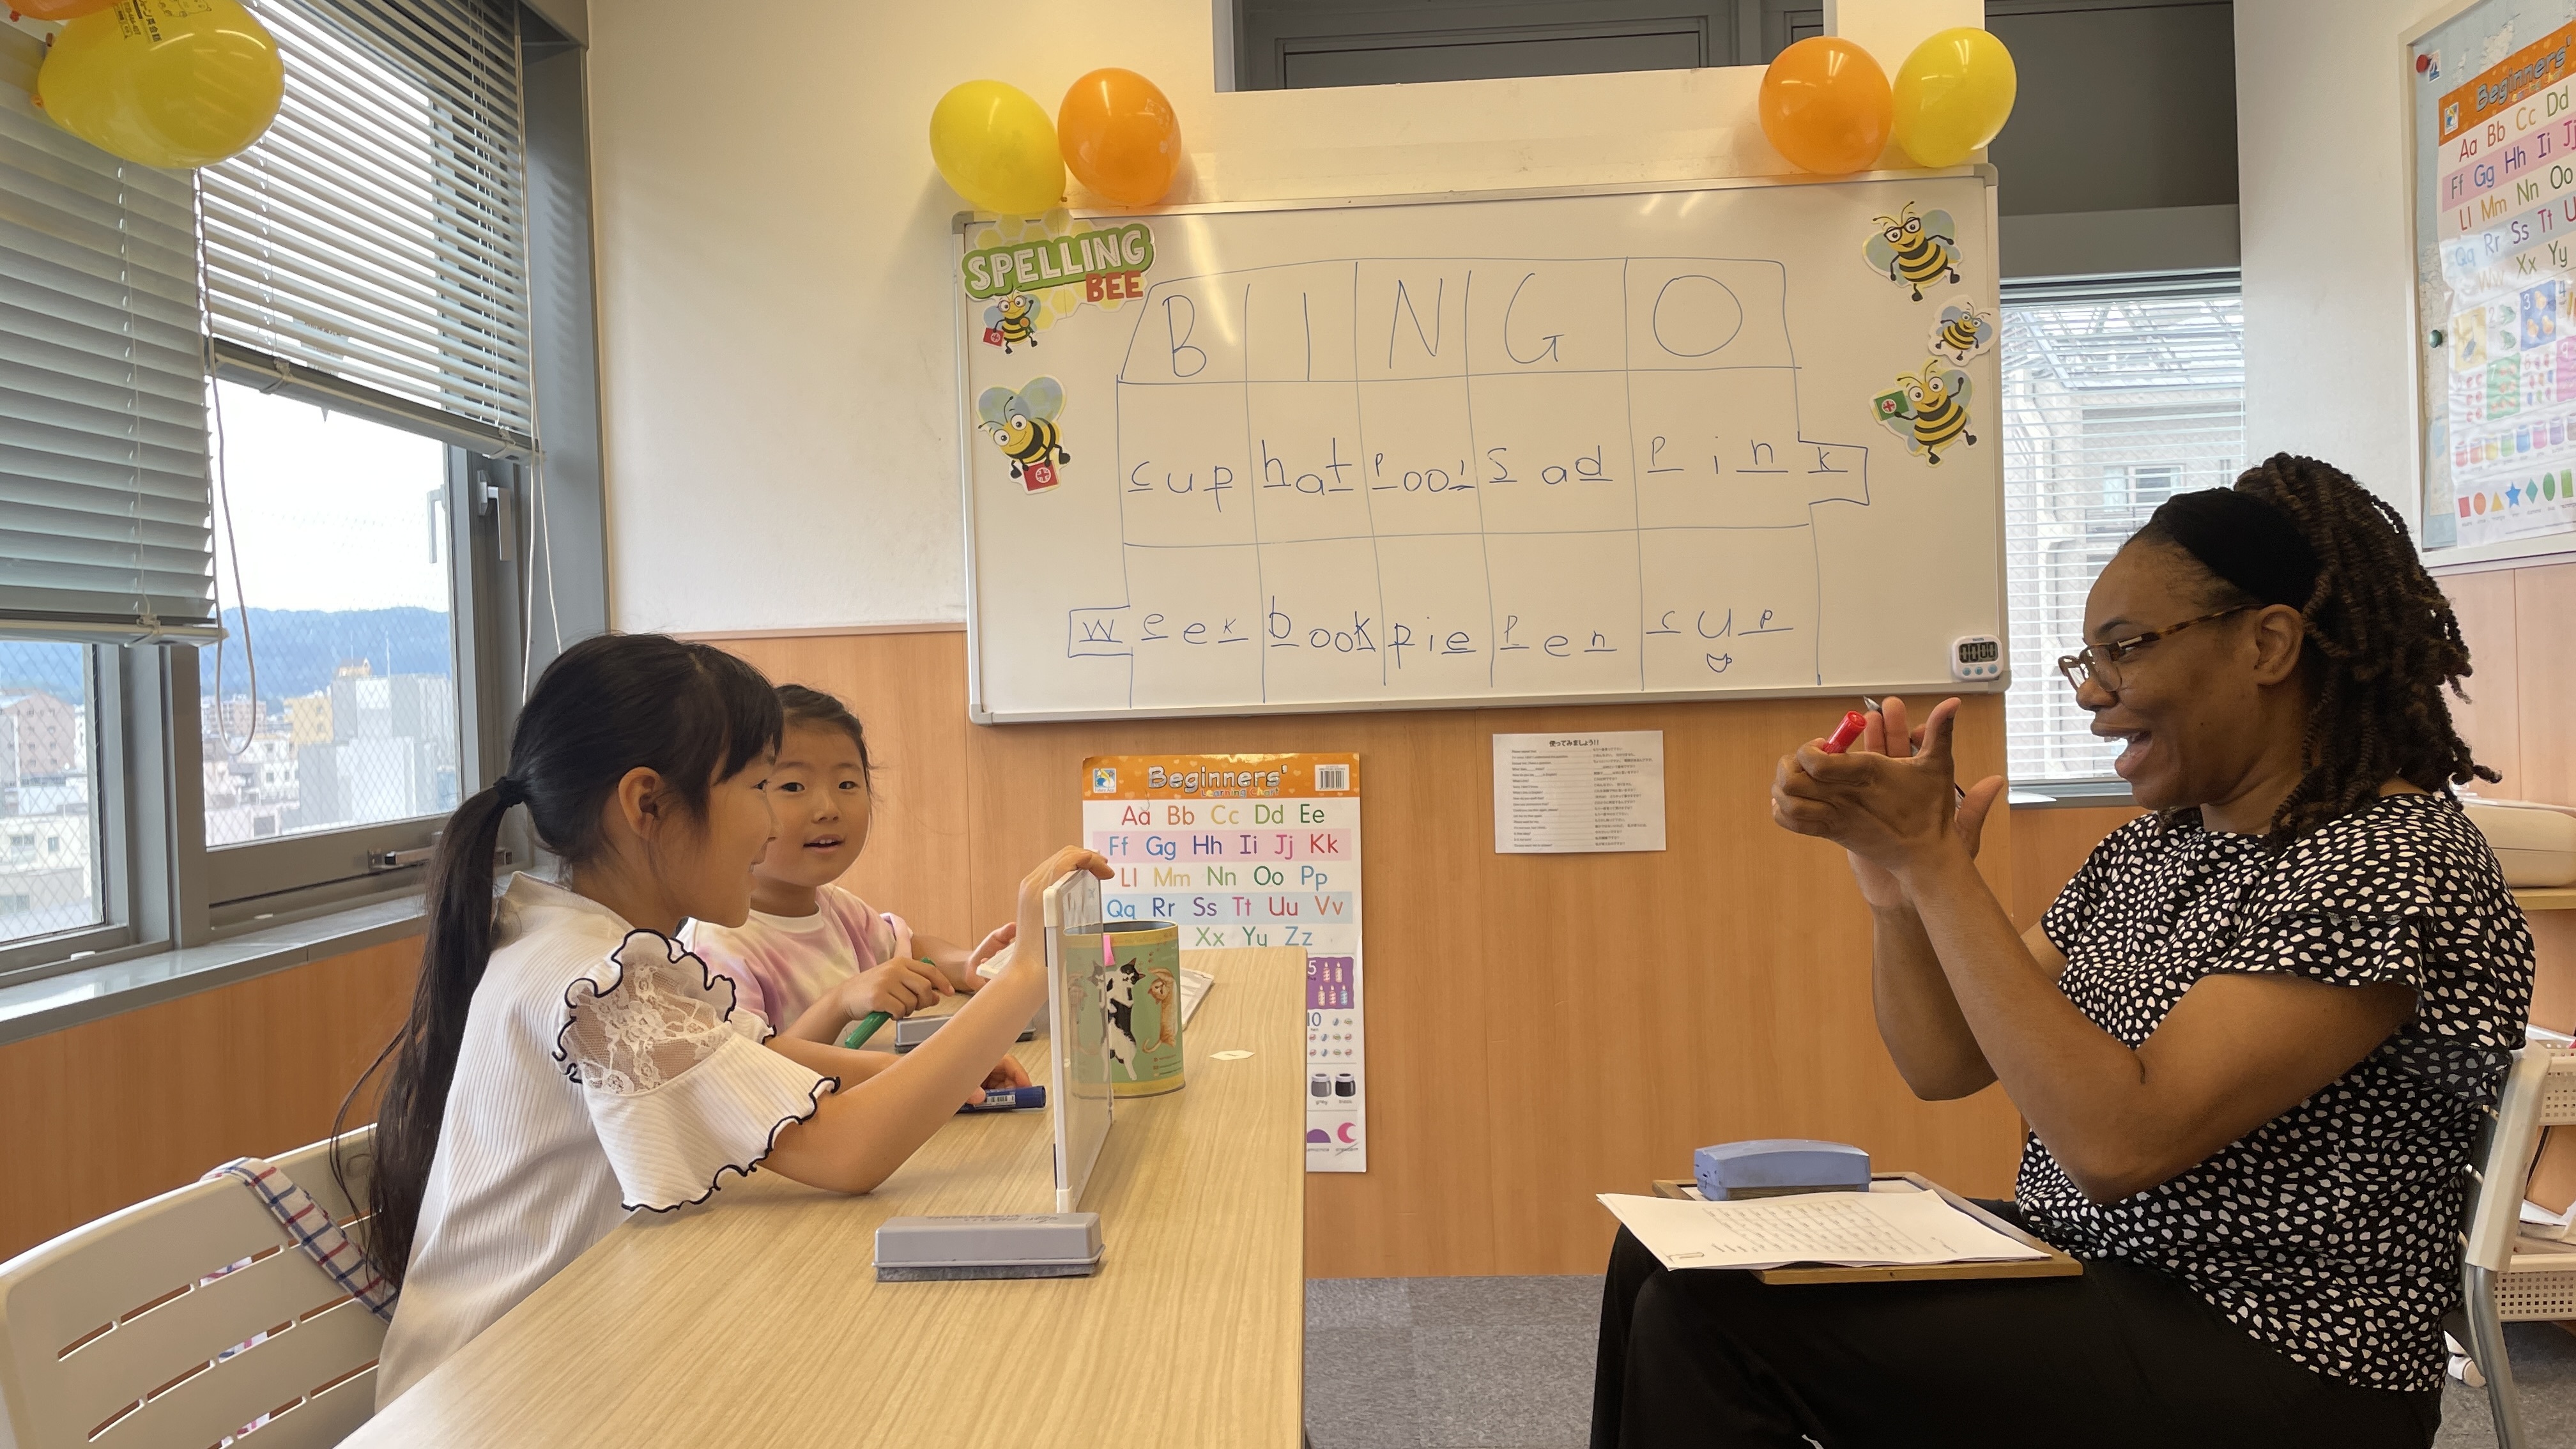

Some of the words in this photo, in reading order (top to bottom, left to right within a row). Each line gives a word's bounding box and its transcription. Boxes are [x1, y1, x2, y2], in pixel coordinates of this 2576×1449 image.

[2477, 34, 2572, 112] Beginners'
[2460, 139, 2477, 162] Aa
[2488, 121, 2505, 147] Bb
[2516, 107, 2536, 130] Cc
[2547, 85, 2568, 118] Dd
[2451, 173, 2464, 199] Ff
[2474, 164, 2495, 188] Gg
[2505, 146, 2526, 174] Hh
[2537, 132, 2551, 158] Ii
[2460, 206, 2472, 231] Ll
[2481, 194, 2507, 222] Mm
[2517, 179, 2539, 206] Nn
[2550, 165, 2573, 189] Oo
[2455, 247, 2476, 267] Qq
[2483, 233, 2499, 256] Rr
[2511, 221, 2529, 244] Ss
[2538, 208, 2552, 233] Tt
[967, 230, 1146, 291] SPELLING
[2516, 254, 2537, 279] Xx
[2548, 240, 2568, 268] Yy
[1086, 271, 1144, 303] BEE
[2524, 293, 2531, 310] 3
[2559, 280, 2566, 298] 4
[2562, 342, 2568, 358] 9
[1128, 461, 1233, 512] cup
[1262, 437, 1354, 496] hat
[1388, 616, 1476, 670] pie
[1148, 764, 1288, 794] Beginners'
[1200, 788, 1248, 799] Learning
[1250, 786, 1280, 797] Chart
[1121, 805, 1151, 826] Aa
[1167, 805, 1195, 825] Bb
[1211, 804, 1239, 825] Cc
[1255, 804, 1284, 824] Dd
[1300, 803, 1325, 824] Ee
[1108, 836, 1128, 856] Ff
[1146, 836, 1176, 861] Gg
[1193, 835, 1222, 855] Hh
[1239, 834, 1257, 855] Ii
[1274, 834, 1294, 860] Jj
[1310, 833, 1339, 854] Kk
[1121, 867, 1137, 887] Ll
[1153, 867, 1191, 887] Mm
[1208, 866, 1236, 886] Nn
[1254, 866, 1284, 885] Oo
[1301, 865, 1328, 892] Pp
[1107, 899, 1137, 920] Qq
[1153, 897, 1176, 917] Rr
[1193, 896, 1218, 917] Ss
[1232, 896, 1252, 917] Tt
[1268, 896, 1298, 917] Uu
[1315, 895, 1344, 916] Vv
[1195, 926, 1225, 947] Xx
[1285, 926, 1314, 946] Zz
[1307, 960, 1317, 976] 5
[1307, 1012, 1322, 1027] 10
